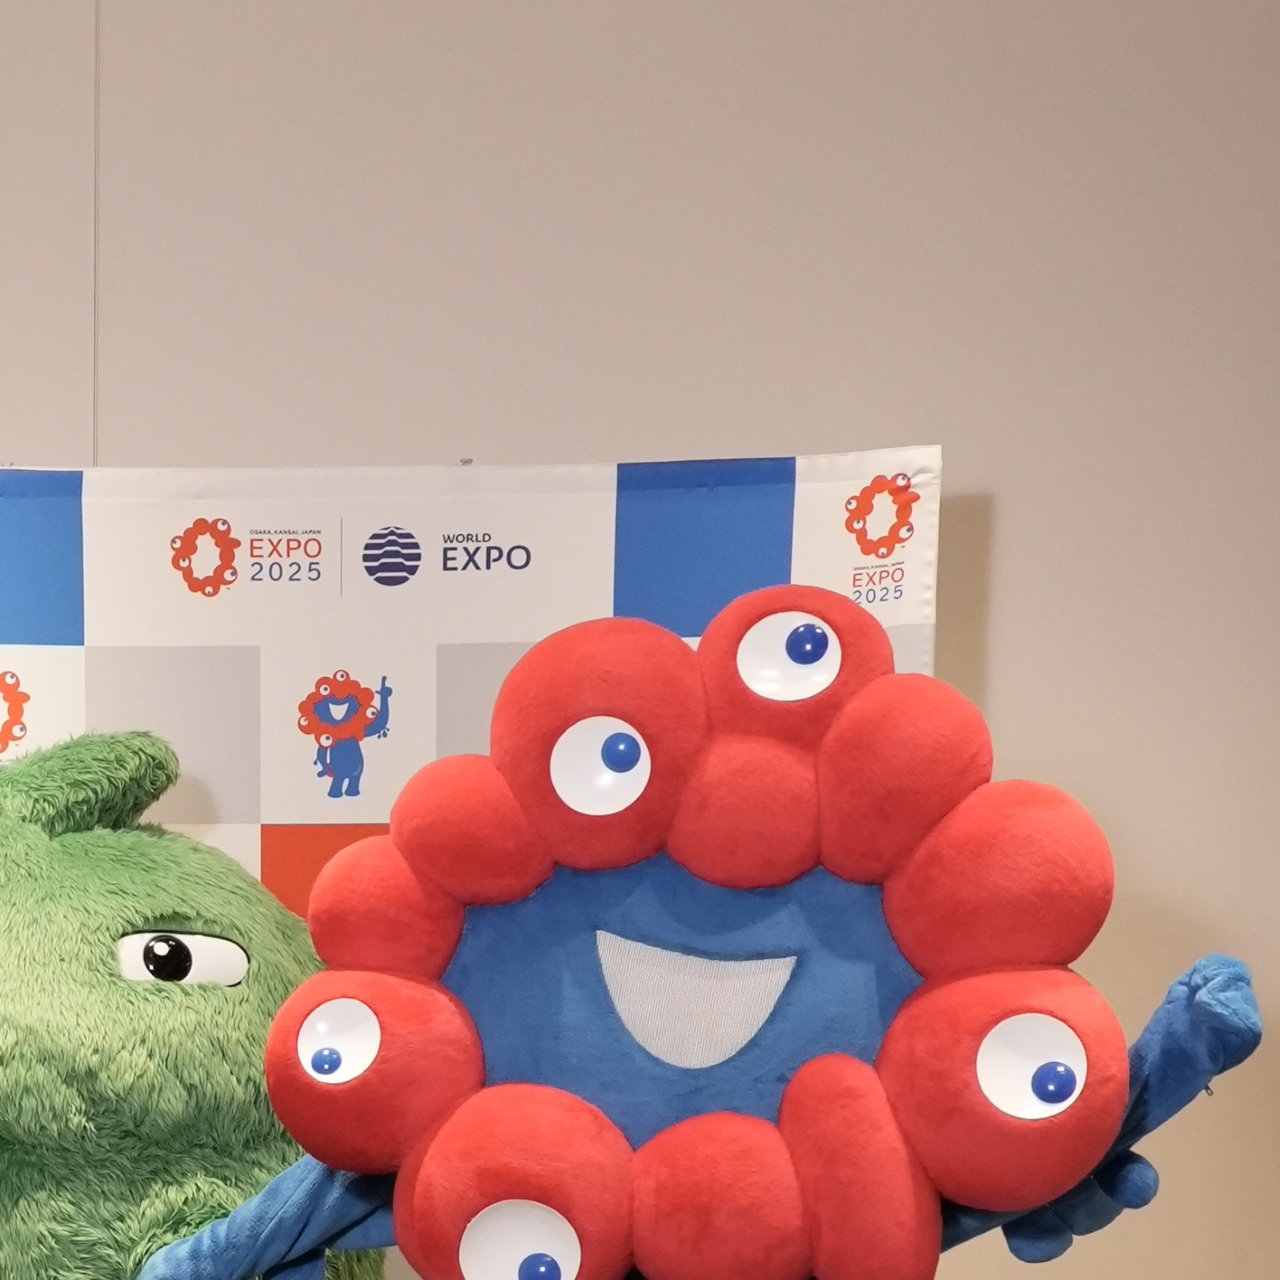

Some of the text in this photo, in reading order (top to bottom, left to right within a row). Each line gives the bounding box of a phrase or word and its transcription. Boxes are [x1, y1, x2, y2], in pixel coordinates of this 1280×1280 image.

[249, 537, 322, 558] EXPO
[442, 532, 492, 544] WORLD
[442, 544, 532, 571] EXPO
[250, 561, 322, 581] 2025
[852, 567, 905, 588] EXPO
[852, 584, 904, 605] 2025
